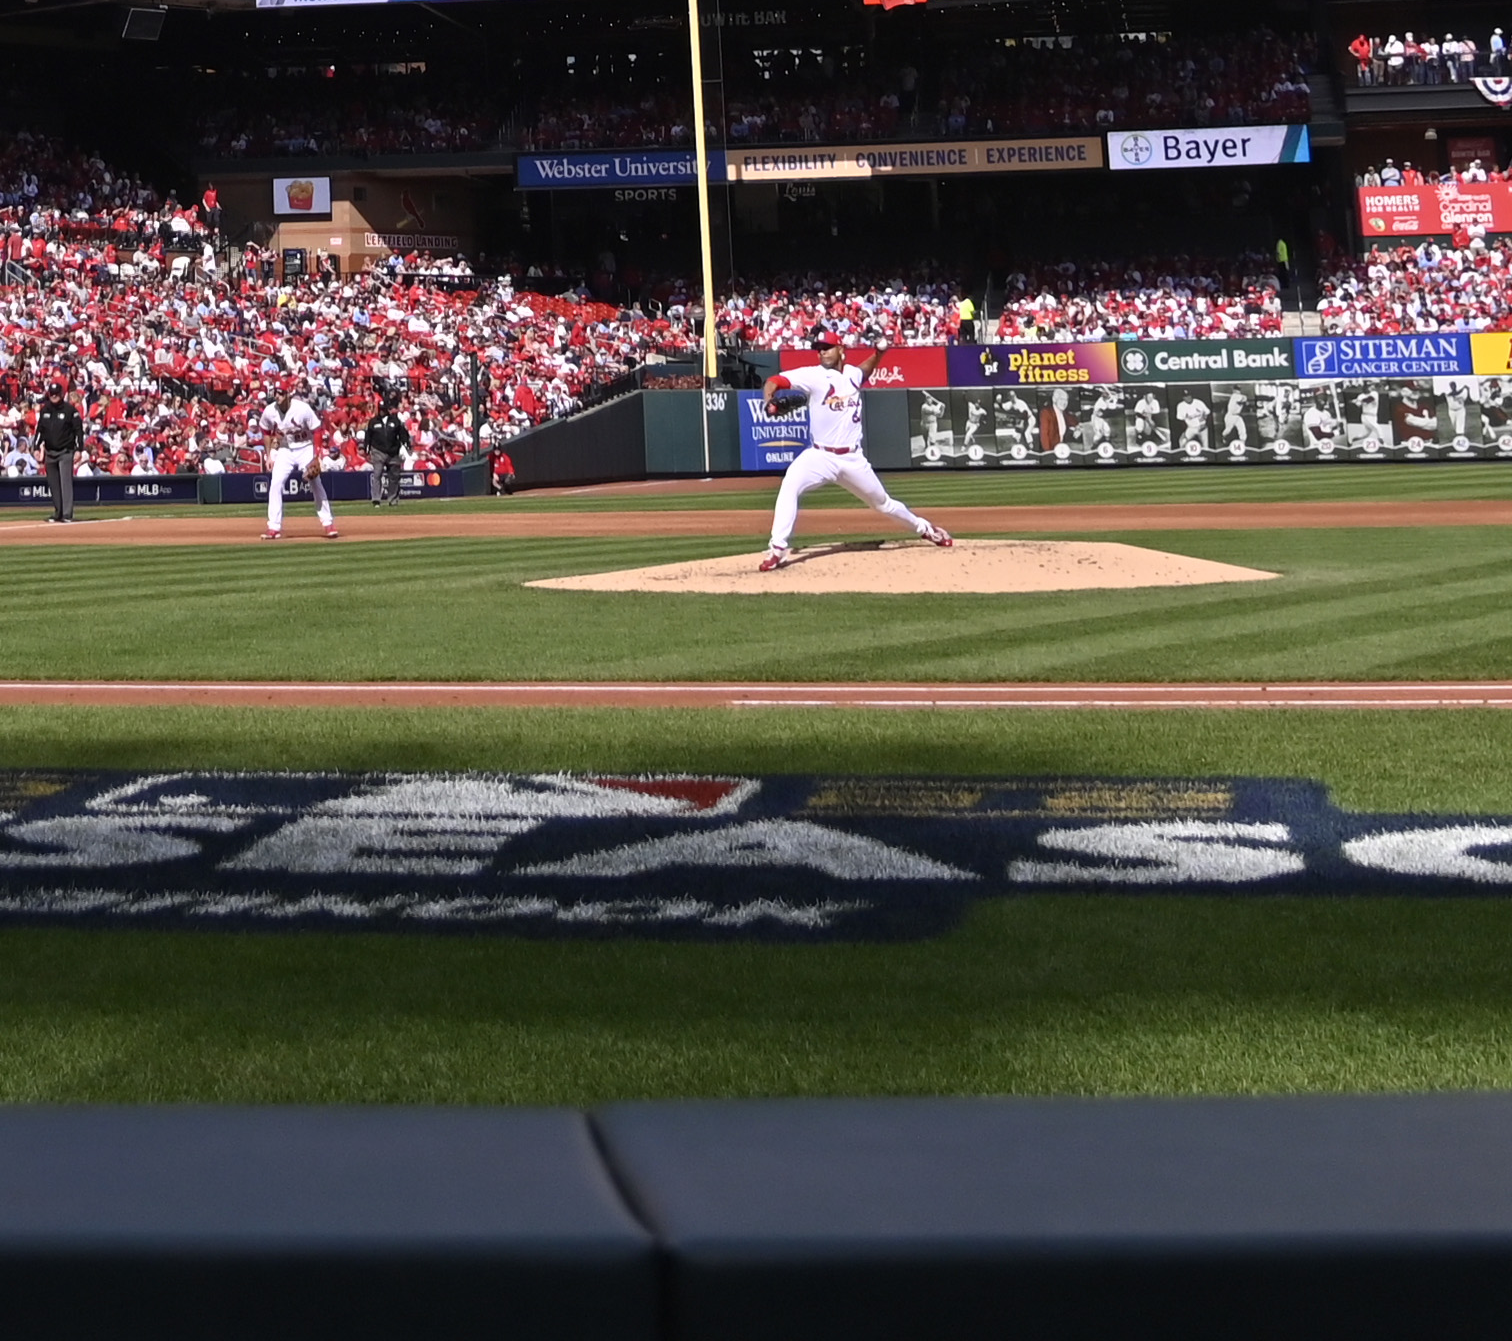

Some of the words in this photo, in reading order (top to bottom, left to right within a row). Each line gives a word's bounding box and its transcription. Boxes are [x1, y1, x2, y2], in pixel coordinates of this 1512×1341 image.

[1163, 135, 1251, 163] Bayer
[744, 153, 837, 172] FLEXIBILITY
[855, 149, 967, 168] CONVENIENCE
[986, 145, 1087, 165] EXPERIENCE
[534, 158, 610, 180] Webster
[614, 188, 677, 202] SPORTS
[1365, 195, 1420, 206] HOMERS
[1439, 196, 1492, 212] Cardinal
[415, 234, 458, 249] LANDING
[1340, 338, 1458, 359] SITEMAN
[1008, 349, 1076, 371] planet
[1154, 349, 1228, 371] Central
[1233, 347, 1290, 368] Bank
[1341, 361, 1398, 374] CANCER
[1400, 360, 1460, 373] CENTER
[1019, 367, 1090, 383] fitness
[706, 392, 728, 411] 336'
[751, 424, 809, 441] UNIVERSITY
[766, 451, 795, 464] ONLINE
[136, 483, 159, 496] MLB
